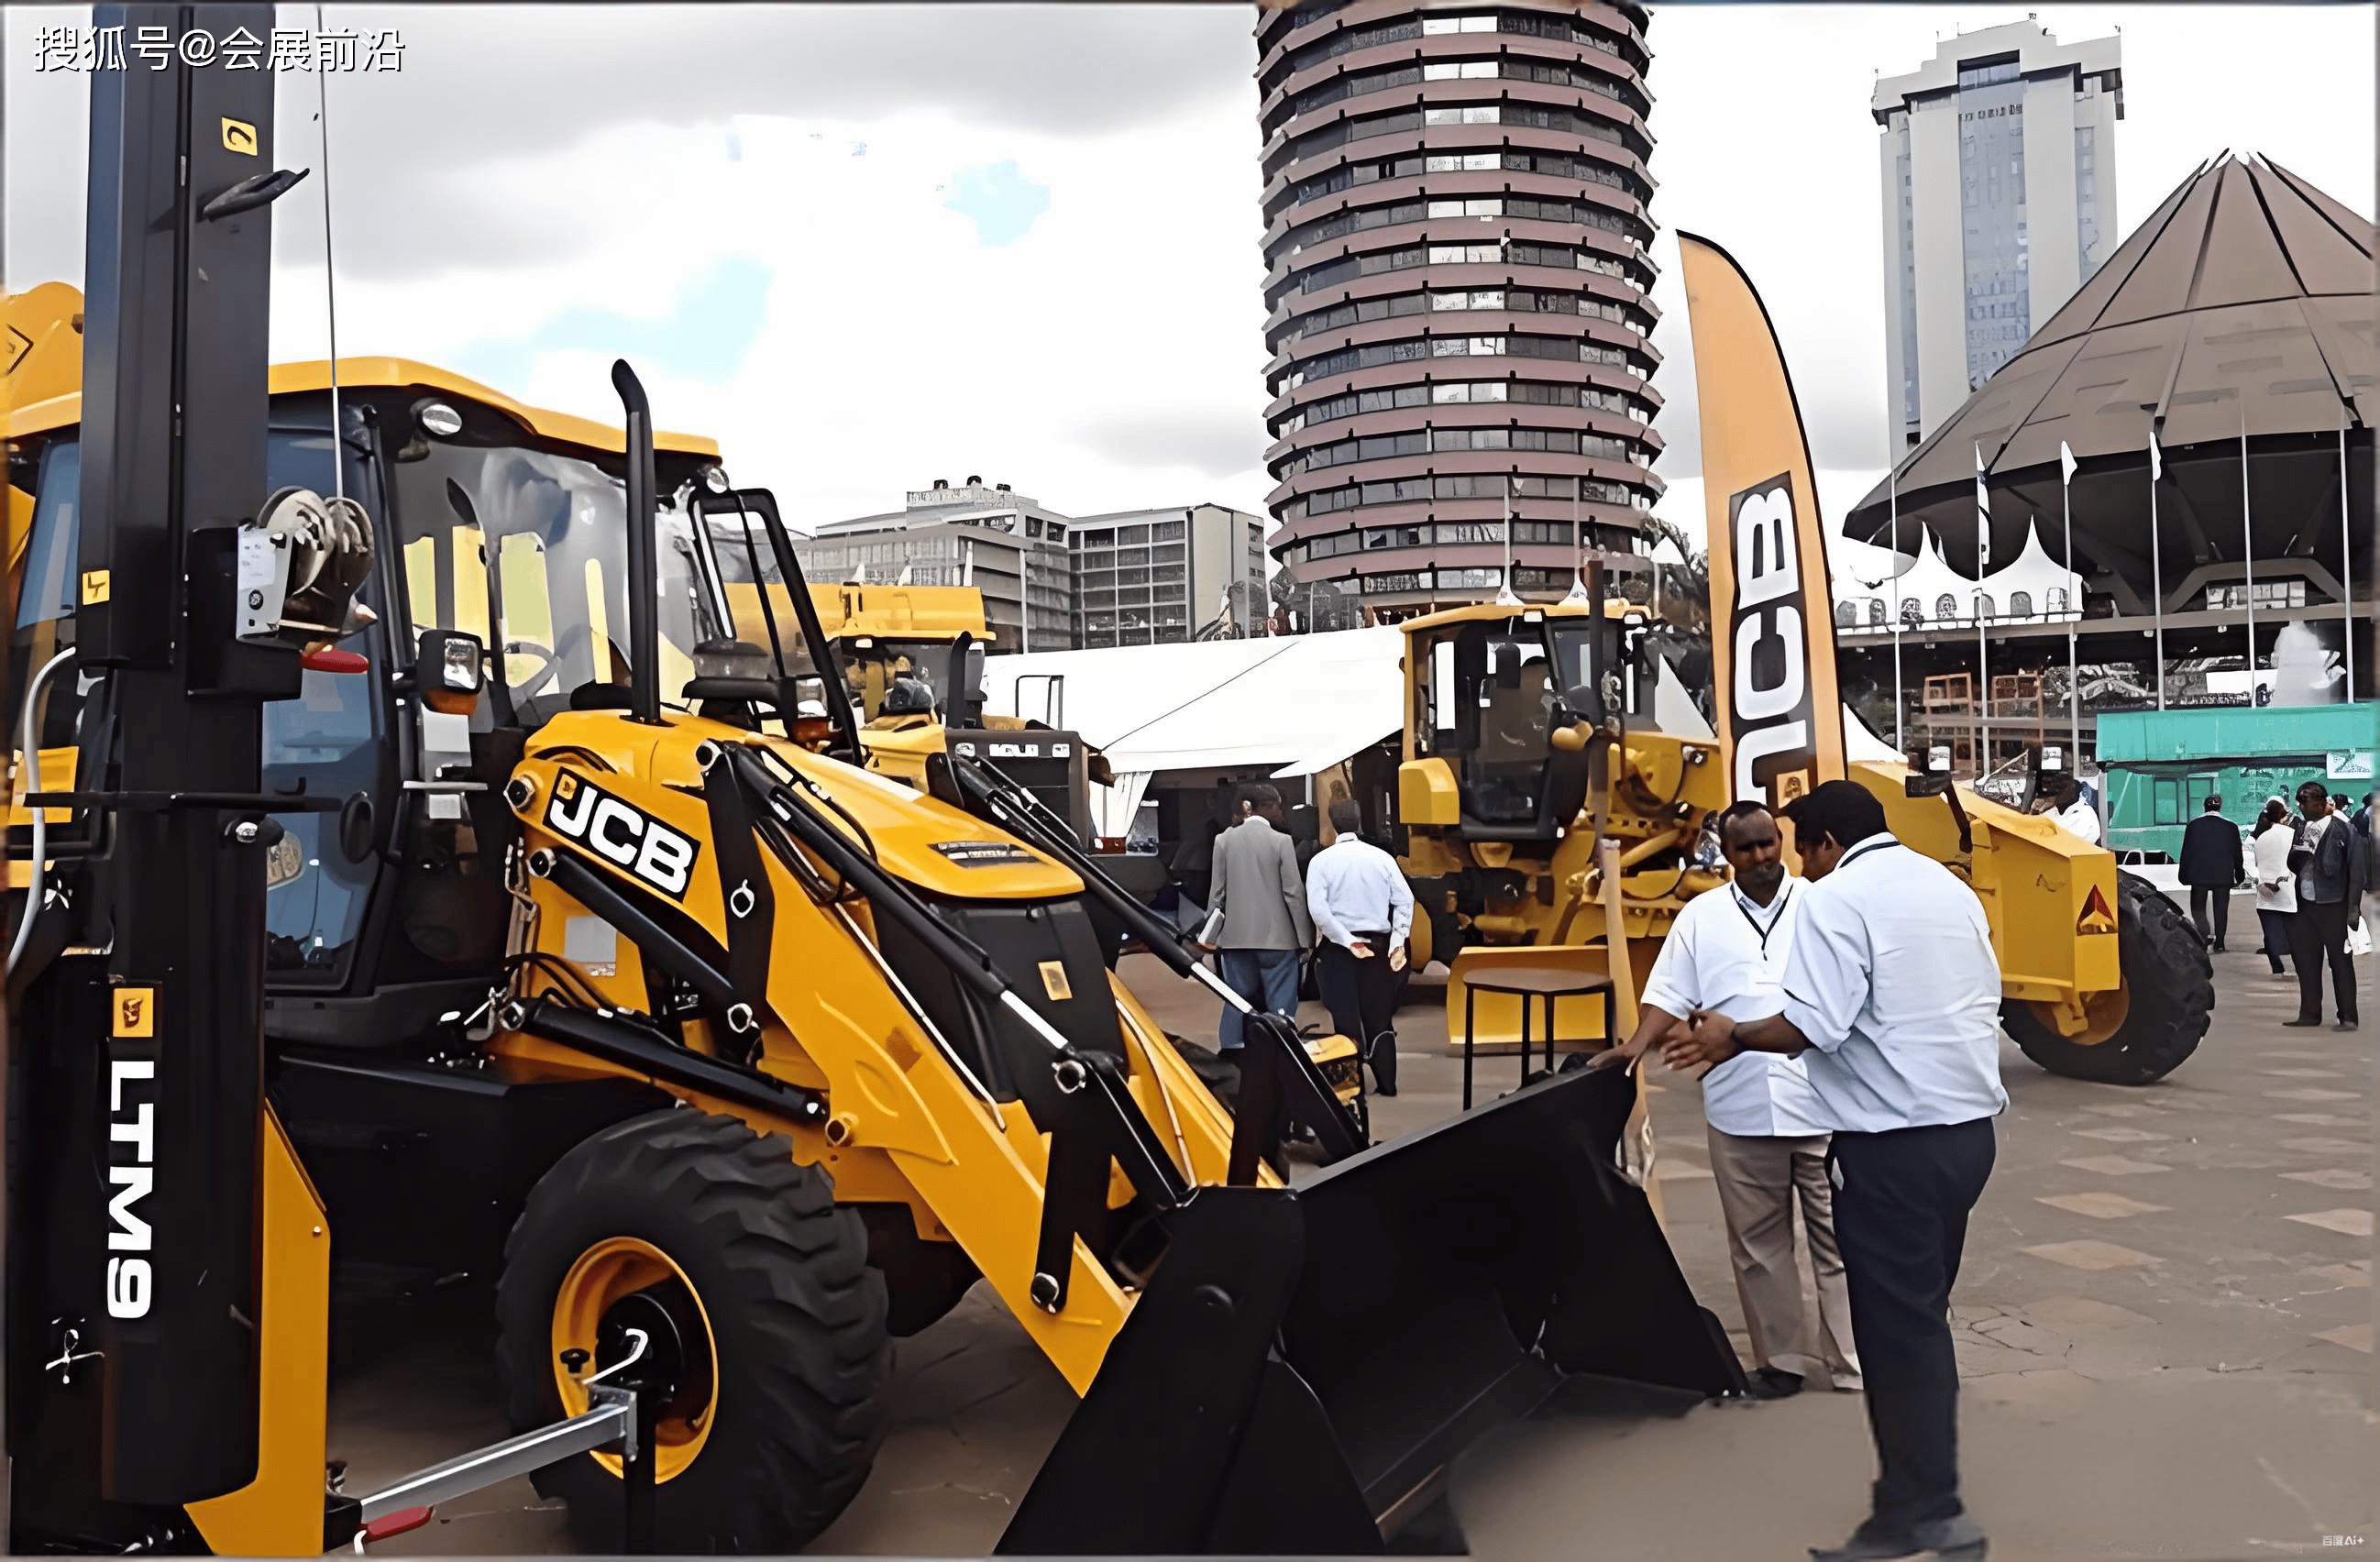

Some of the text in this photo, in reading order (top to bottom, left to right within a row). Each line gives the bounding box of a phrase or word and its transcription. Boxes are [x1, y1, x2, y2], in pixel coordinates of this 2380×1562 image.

[1735, 486, 1807, 807] JCB
[550, 786, 692, 894] JCB
[107, 1061, 154, 1319] LTM9
